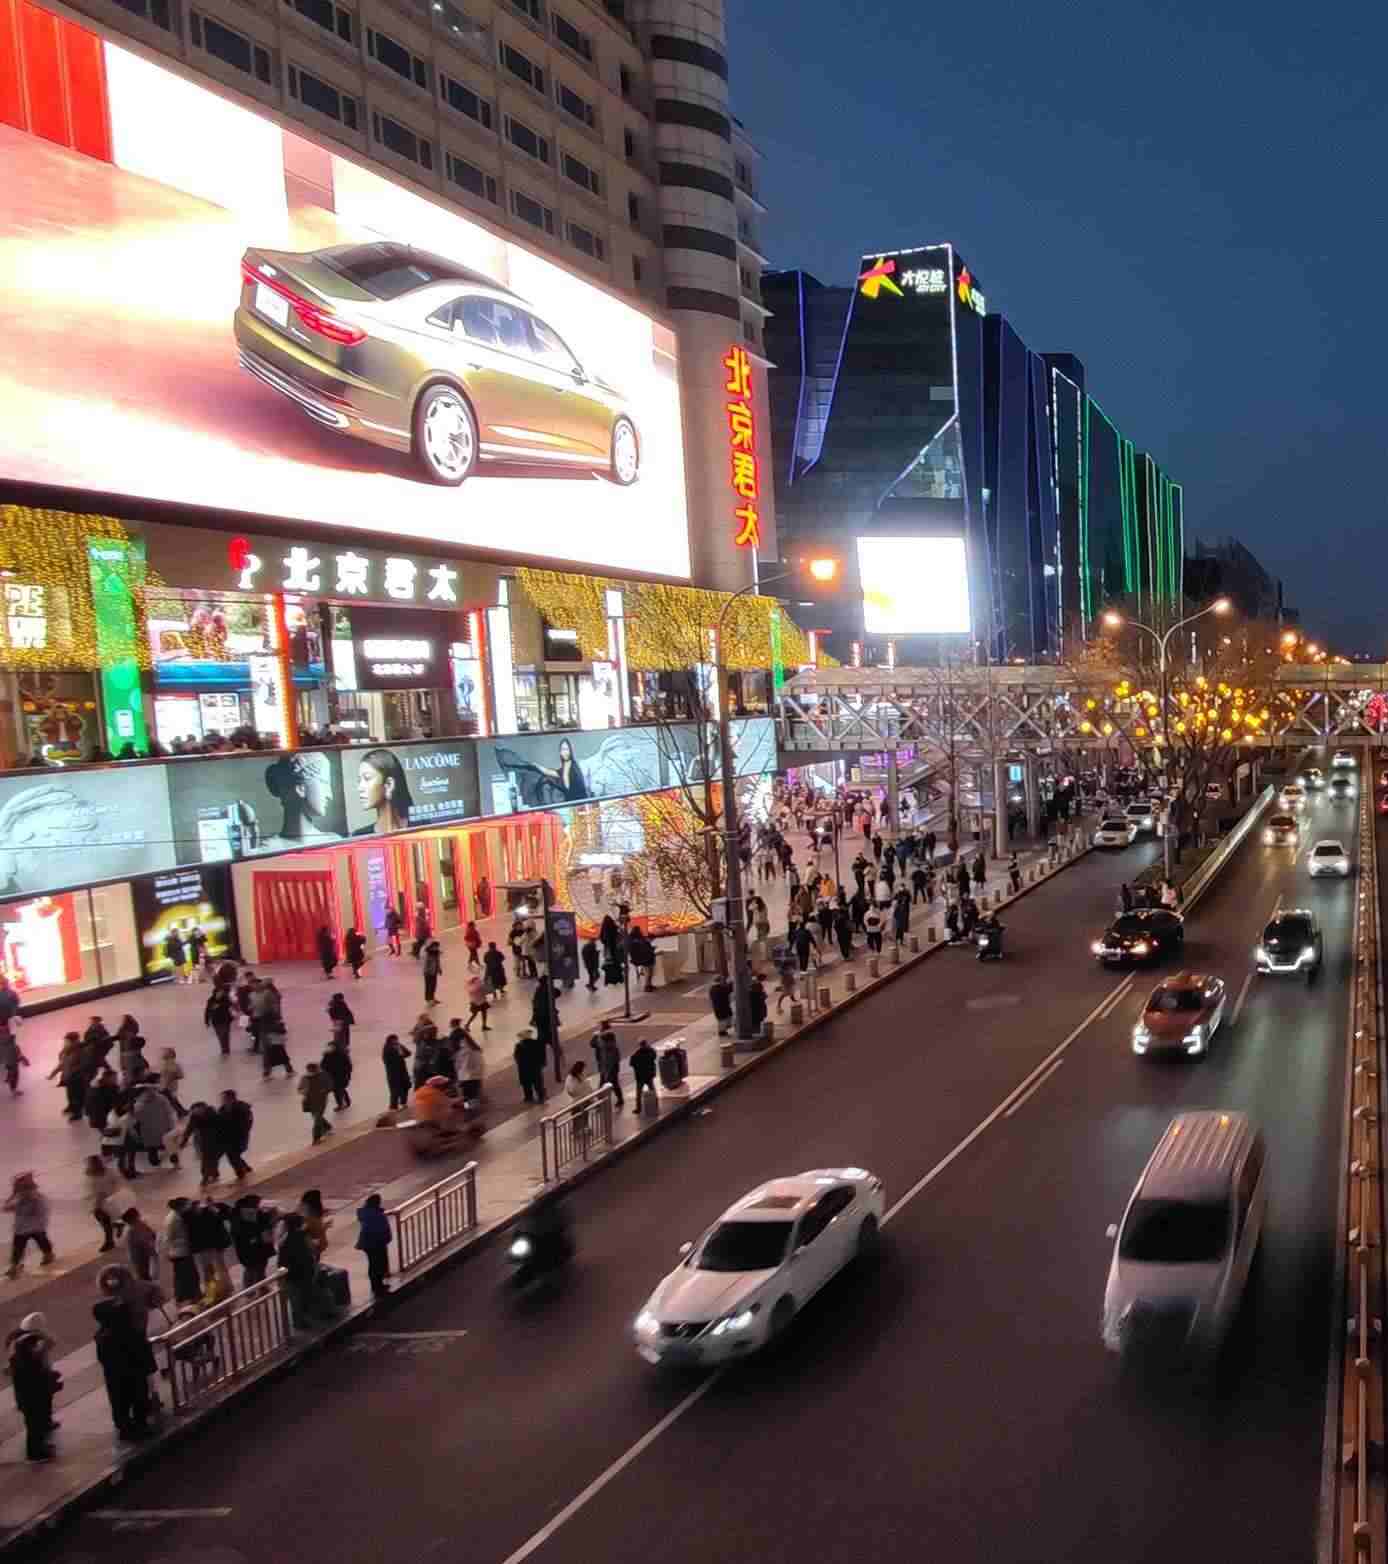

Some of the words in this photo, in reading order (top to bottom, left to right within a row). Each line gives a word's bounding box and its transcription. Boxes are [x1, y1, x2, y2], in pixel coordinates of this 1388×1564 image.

[724, 346, 760, 548] 北京君太
[283, 547, 457, 602] 北京君太
